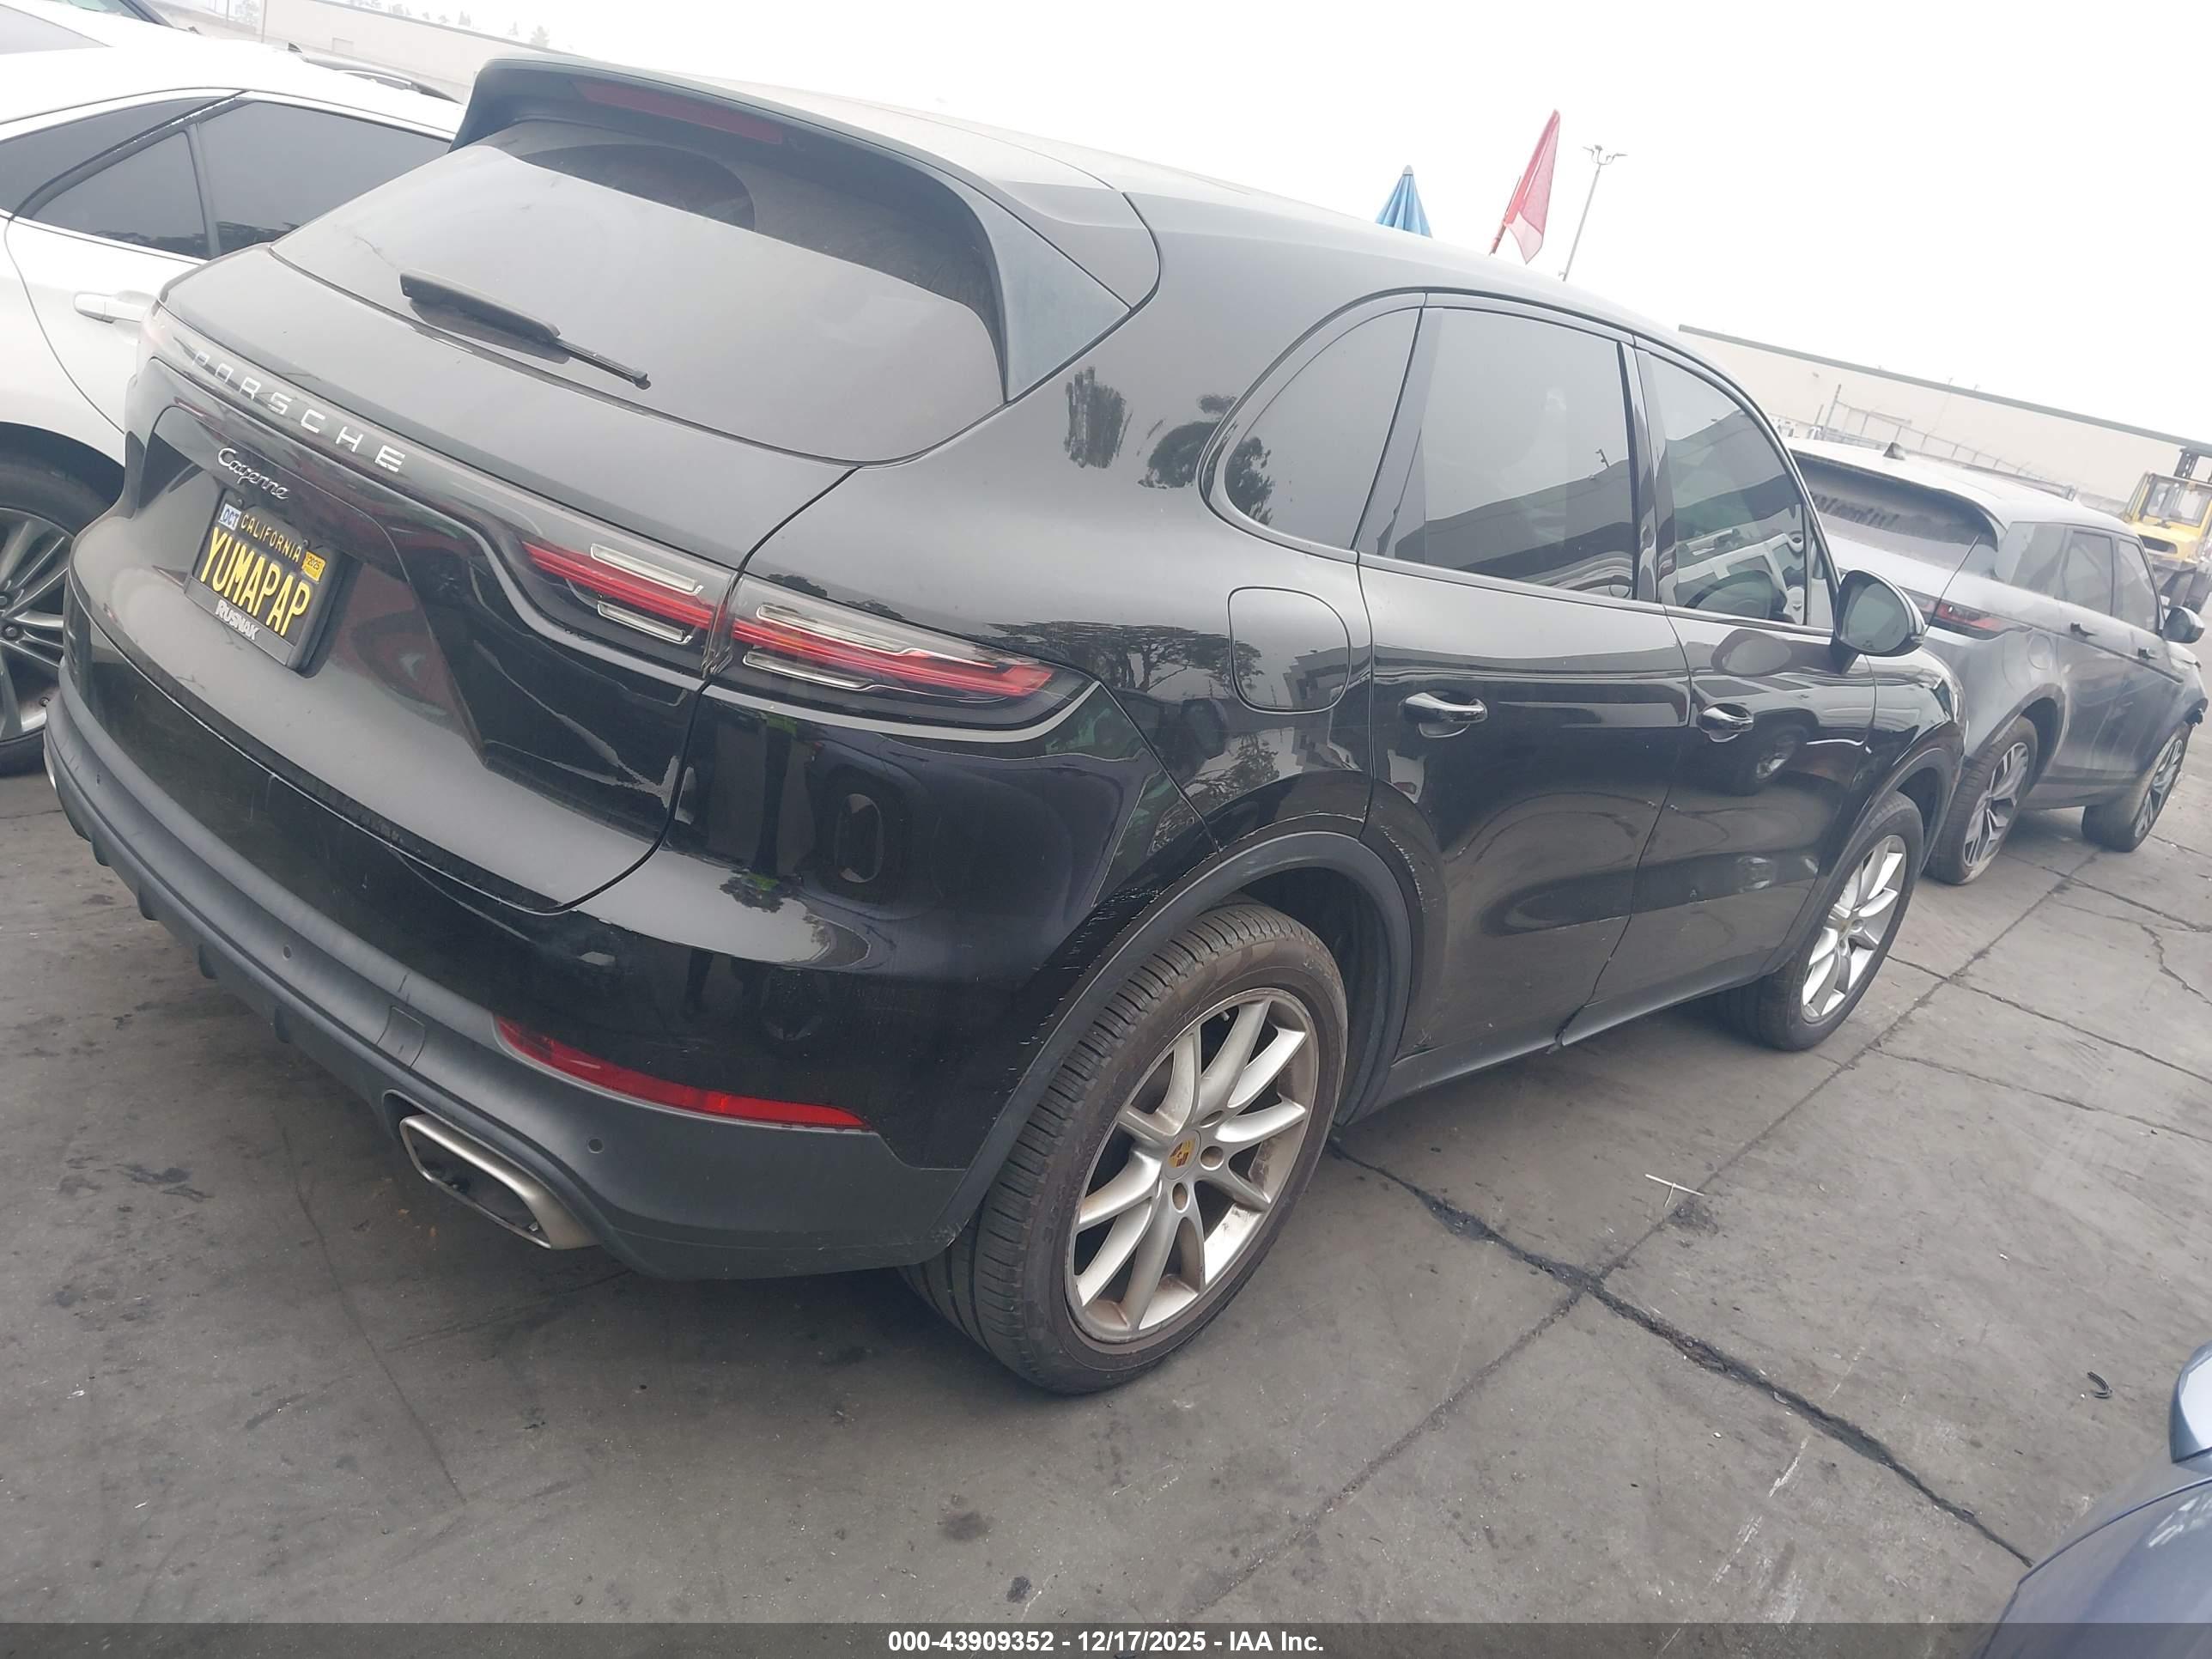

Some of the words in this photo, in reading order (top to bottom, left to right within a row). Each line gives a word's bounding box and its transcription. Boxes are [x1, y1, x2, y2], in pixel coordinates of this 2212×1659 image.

[192, 349, 407, 474] PORSCHE
[217, 447, 290, 501] Cayenne
[222, 507, 240, 528] OCT
[240, 514, 303, 563] CALIFORNIA
[200, 526, 311, 637] YUMAPAP
[215, 599, 260, 641] RUSNAK
